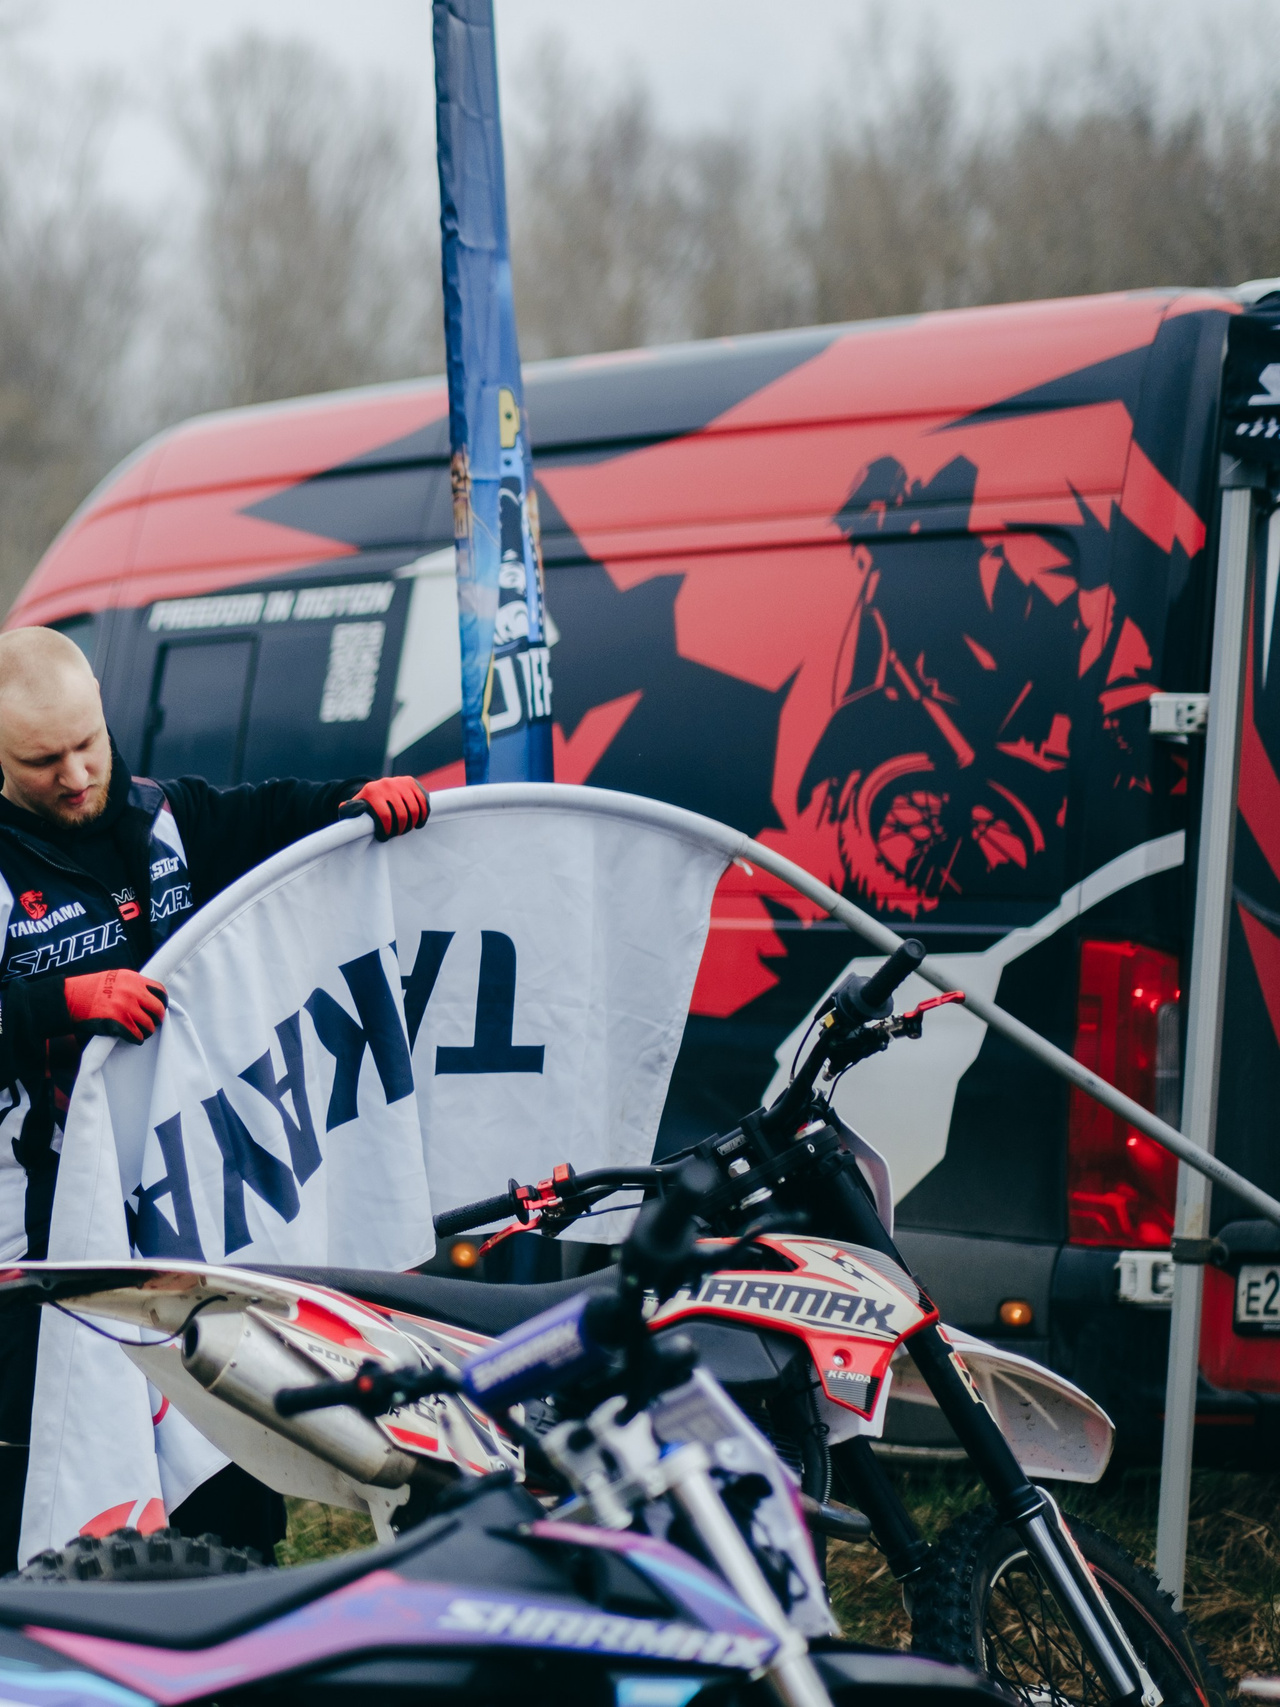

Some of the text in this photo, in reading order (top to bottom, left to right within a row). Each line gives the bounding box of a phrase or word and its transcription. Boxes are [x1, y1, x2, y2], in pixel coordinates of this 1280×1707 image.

[9, 901, 86, 938] TAKAYAMA
[125, 930, 545, 1262] TAKAYA
[687, 1278, 896, 1332] ARMAX
[827, 1369, 872, 1384] KENDA
